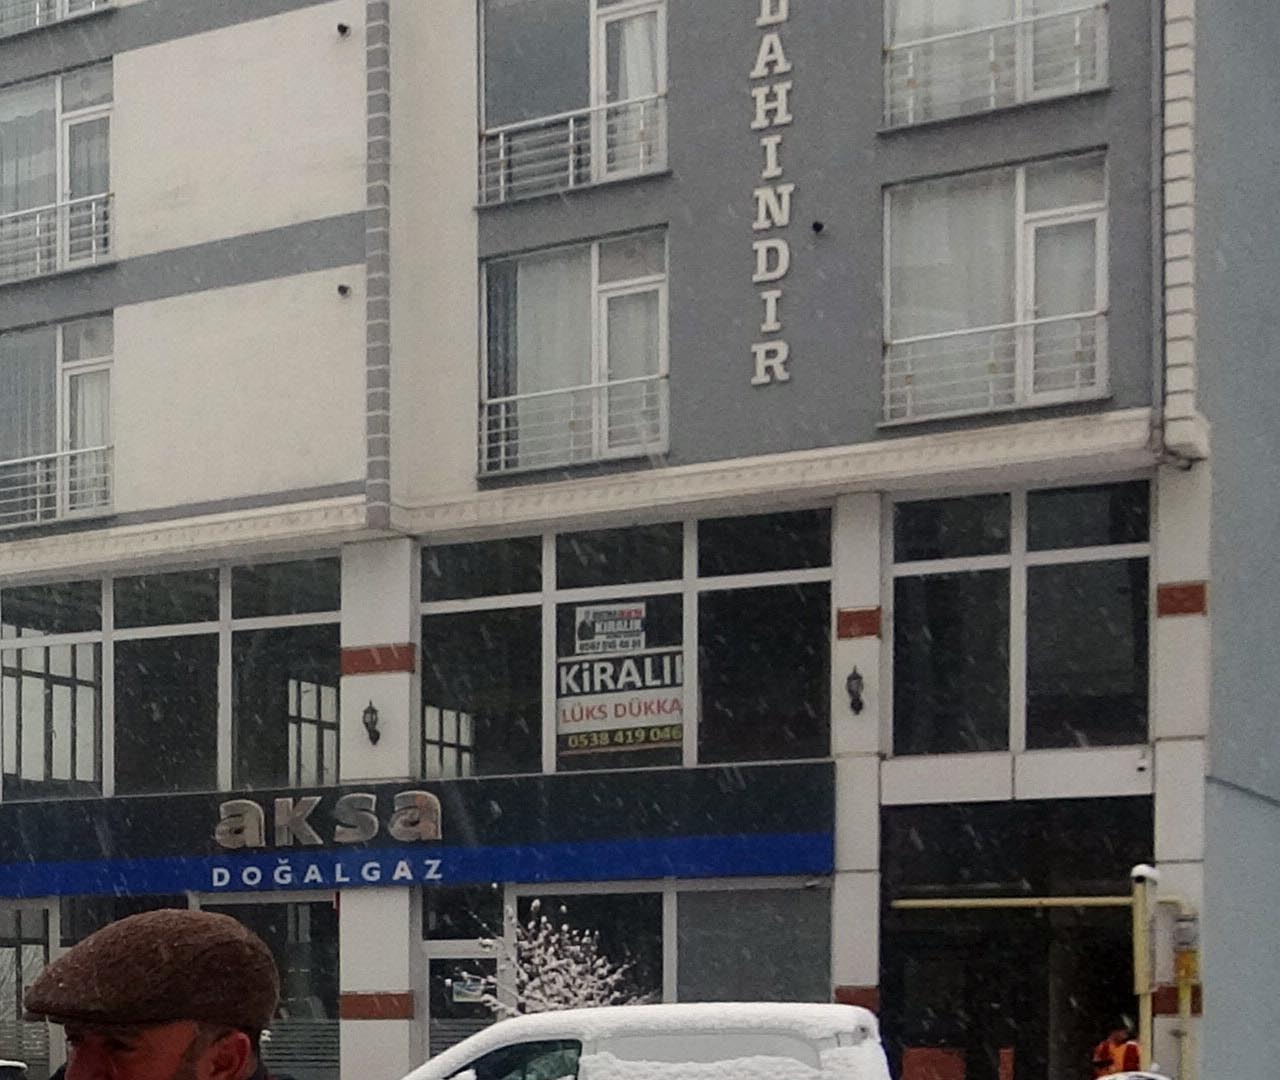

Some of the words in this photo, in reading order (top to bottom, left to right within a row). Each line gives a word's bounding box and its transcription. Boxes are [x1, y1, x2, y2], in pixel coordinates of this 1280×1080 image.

[561, 702, 608, 723] LÜKS
[568, 732, 610, 748] 0538
[614, 729, 646, 744] 419
[213, 789, 442, 848] aksa
[212, 859, 443, 887] DOĞALGAZ
